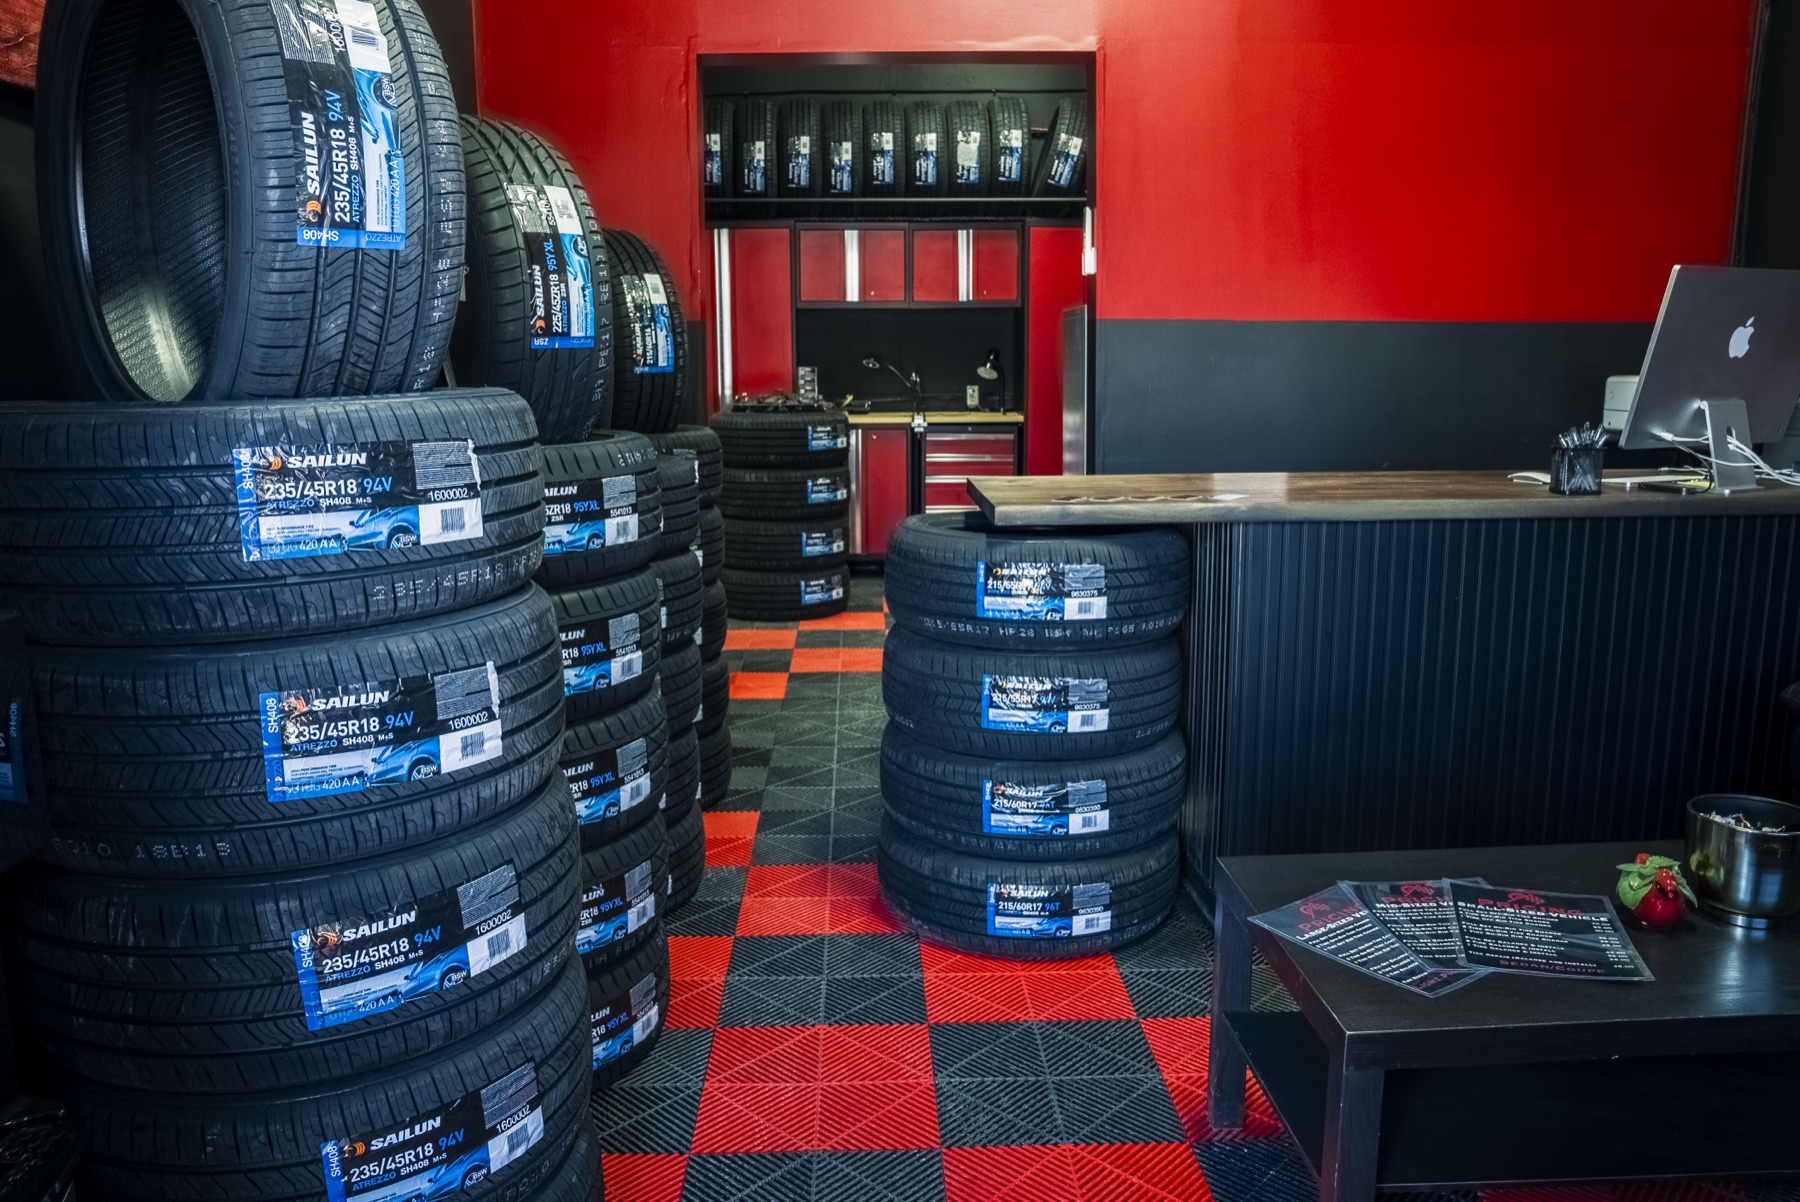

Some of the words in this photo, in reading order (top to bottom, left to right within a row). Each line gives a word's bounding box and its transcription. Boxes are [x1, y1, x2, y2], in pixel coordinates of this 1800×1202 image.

[324, 89, 343, 122] 94V
[301, 112, 321, 195] SAILUN
[349, 137, 359, 171] SH408
[330, 128, 351, 223] 235/45R18
[351, 175, 360, 223] ATREZZO
[303, 229, 340, 242] SH408
[532, 264, 545, 318] SAILUN
[549, 274, 563, 334] 225/45ZR18
[533, 337, 549, 345] ZSR
[287, 452, 366, 469] SAILUN
[264, 479, 358, 501] 235/45R18
[363, 477, 393, 493] 94V
[266, 499, 315, 509] ATREZZO
[319, 496, 352, 506] SH408
[428, 488, 469, 502] 1600002
[300, 539, 318, 551] 420
[312, 690, 390, 711] SAILUN
[265, 698, 279, 734] SH408
[290, 716, 380, 743] 235/45R18
[385, 711, 415, 730] 94V
[448, 711, 489, 731] 1600002
[290, 739, 338, 753] ATREZZO
[342, 735, 375, 747] SH408
[322, 778, 341, 789] 420
[993, 799, 1037, 809] 215/60R17
[998, 901, 1043, 911] 215/60R17
[1045, 902, 1060, 911] 96T
[1457, 901, 1545, 916] SMALL-SIZED
[1549, 911, 1609, 922] VEHICLE
[342, 910, 416, 942] SAILUN
[474, 909, 513, 936] 1600002
[322, 937, 410, 974] 235/45R18
[414, 925, 441, 947] 94V
[325, 965, 371, 983] ATREZZO
[374, 954, 406, 970] SH408
[359, 1001, 377, 1012] 420
[370, 1116, 441, 1150] SAILUN
[495, 1104, 532, 1134] 1600002
[330, 1145, 341, 1177] SH408
[350, 1142, 434, 1182] 235/45R18
[438, 1128, 465, 1151] 94V
[352, 1171, 397, 1192] ATREZZO
[400, 1158, 430, 1175] SH408
